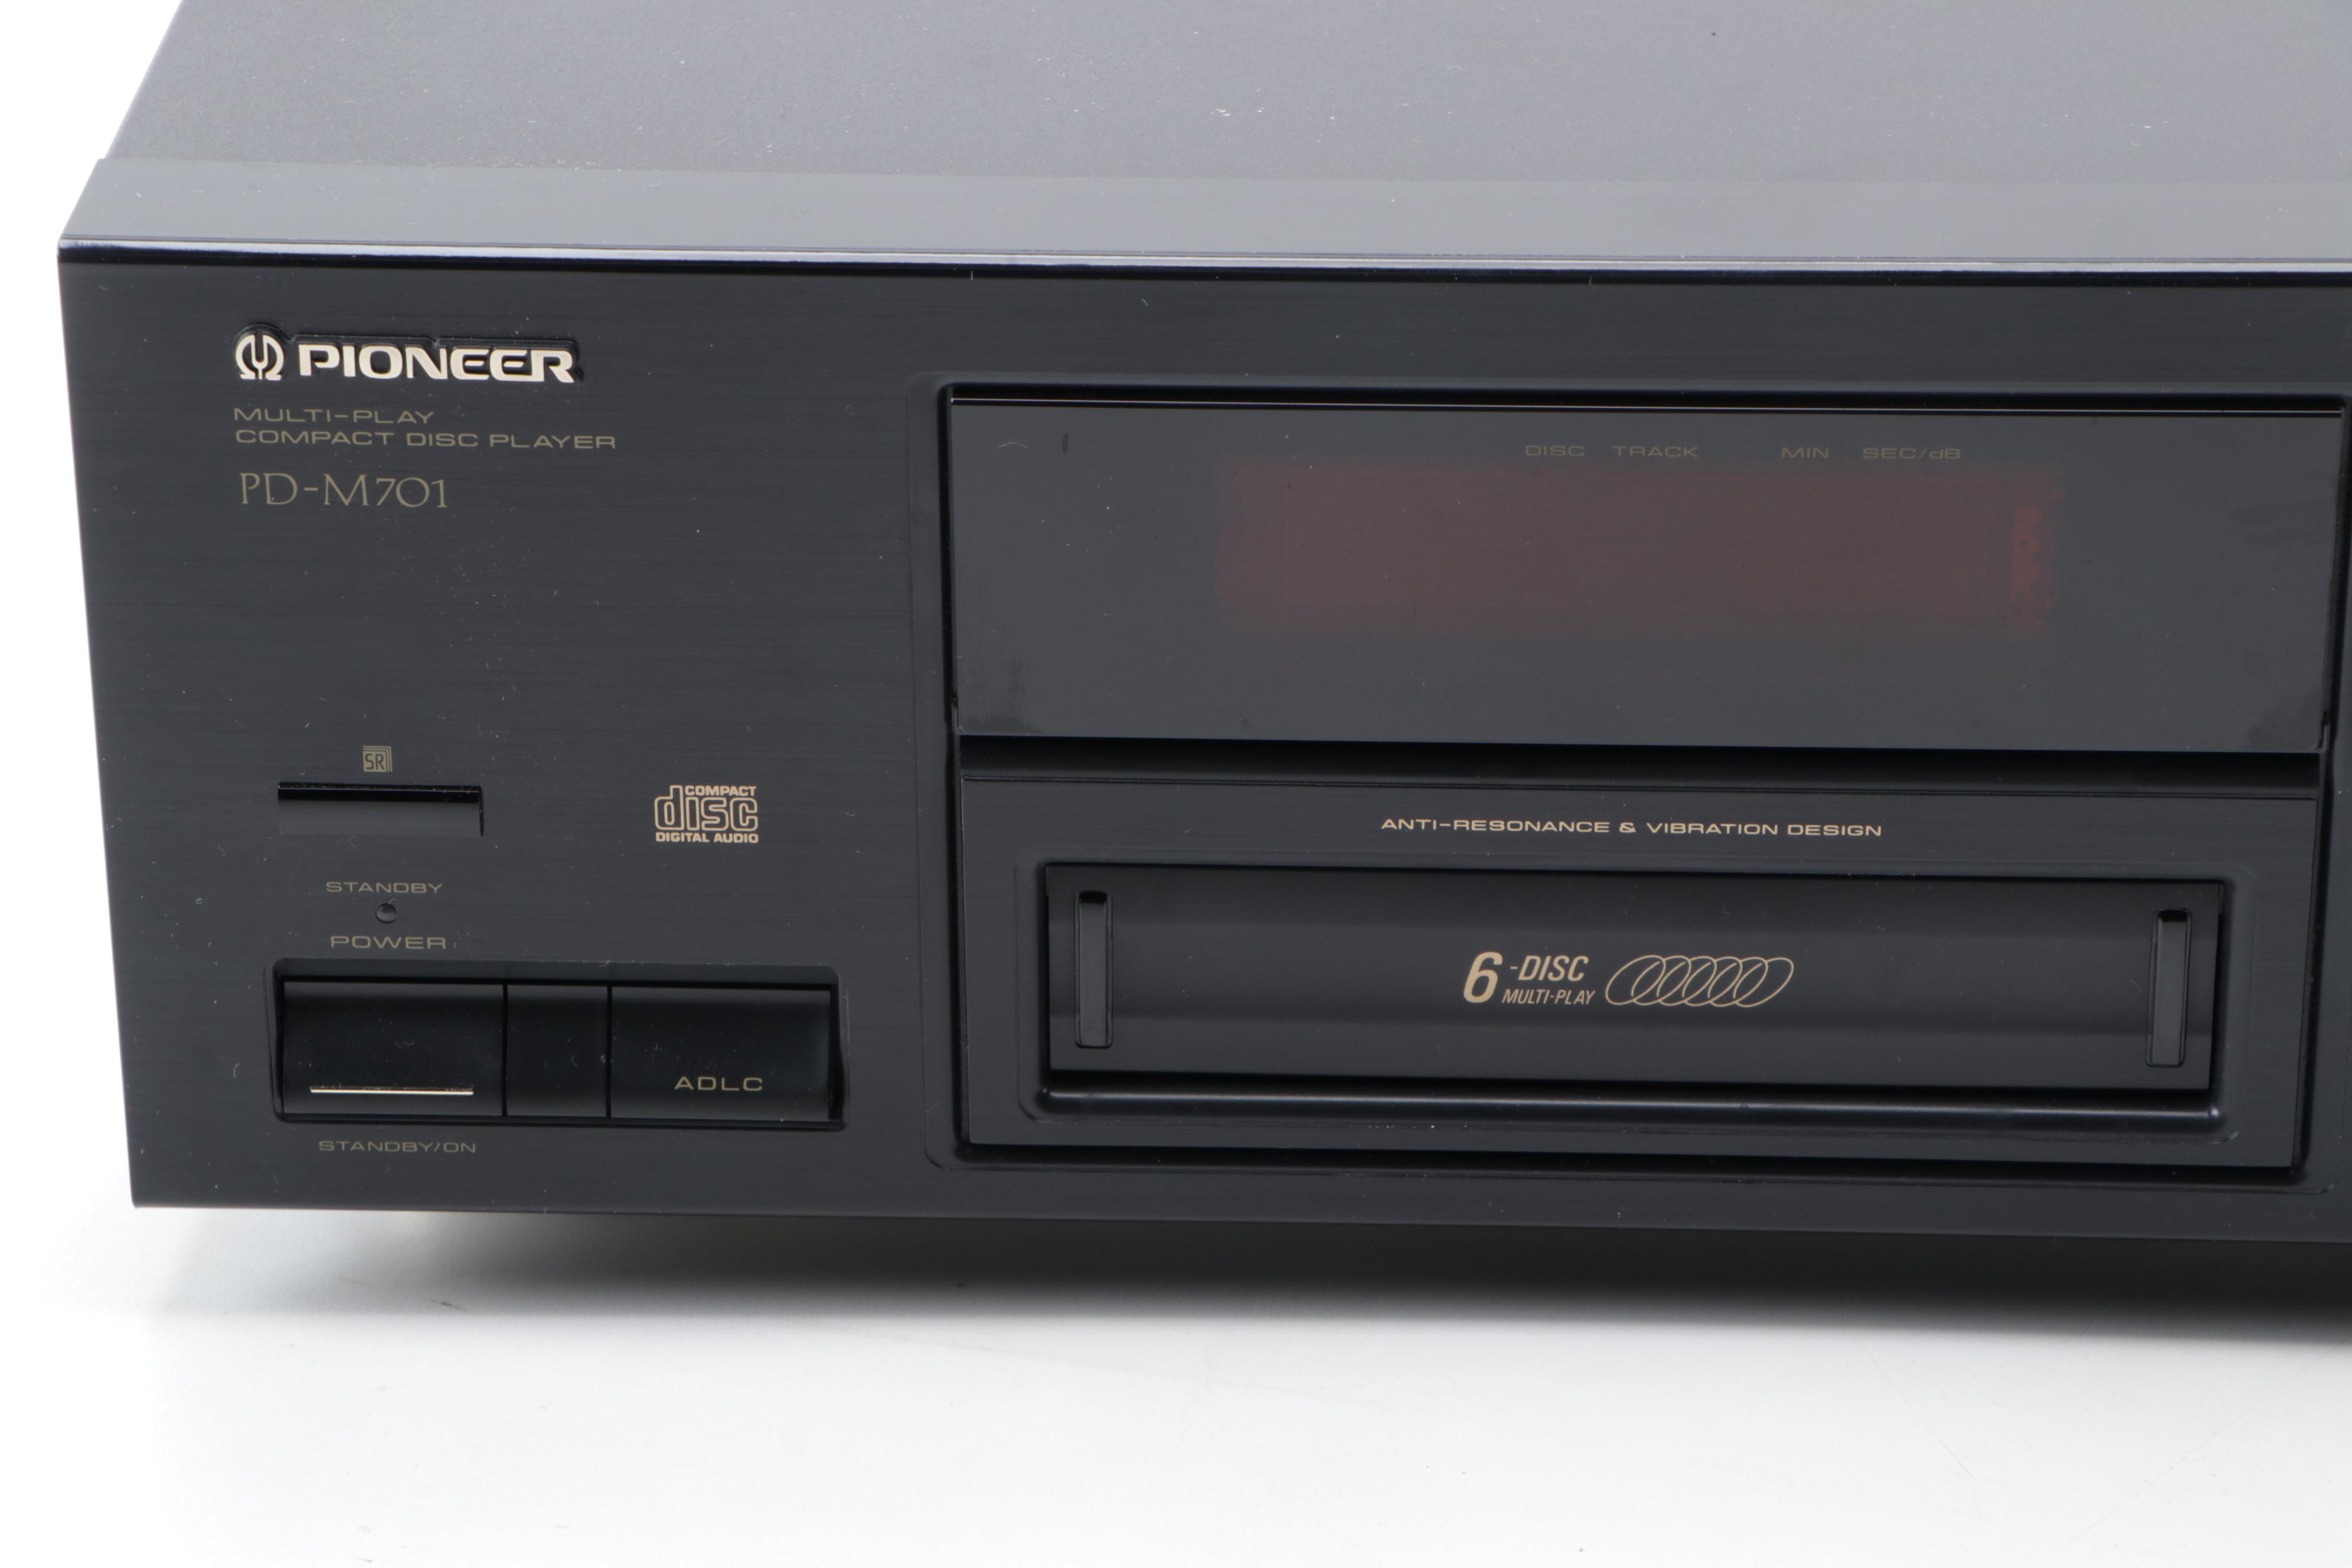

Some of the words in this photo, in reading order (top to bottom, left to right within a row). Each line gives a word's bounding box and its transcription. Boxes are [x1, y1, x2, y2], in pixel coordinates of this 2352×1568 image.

[298, 344, 574, 383] PIONEER
[233, 407, 434, 424] MULTI-PLAY
[236, 429, 394, 445] COMPACT
[406, 432, 478, 447] DISC
[489, 433, 616, 450] PLAYER
[1525, 445, 1585, 458] DISC
[1613, 446, 1698, 458] TRACK
[1781, 446, 1830, 459] MIN
[1863, 447, 1961, 460] SEC/dB
[240, 472, 447, 508] PD-M701
[364, 753, 385, 770] SR
[685, 785, 757, 796] COMPACT
[654, 785, 759, 831] disc
[1381, 818, 1610, 833] ANTI-RESONANCE
[1619, 822, 1636, 833] &
[1647, 822, 1778, 835] VIBRATION
[1787, 824, 1883, 837] DESIGN
[655, 832, 710, 842] DIGITAL
[714, 833, 759, 844] AUDIO
[325, 881, 443, 894] STANDBY
[330, 935, 447, 949] POWER
[1502, 988, 1596, 1005] MULTI-PLAY
[674, 1076, 763, 1092] ADLC
[318, 1140, 476, 1154] STANDBY/ON
